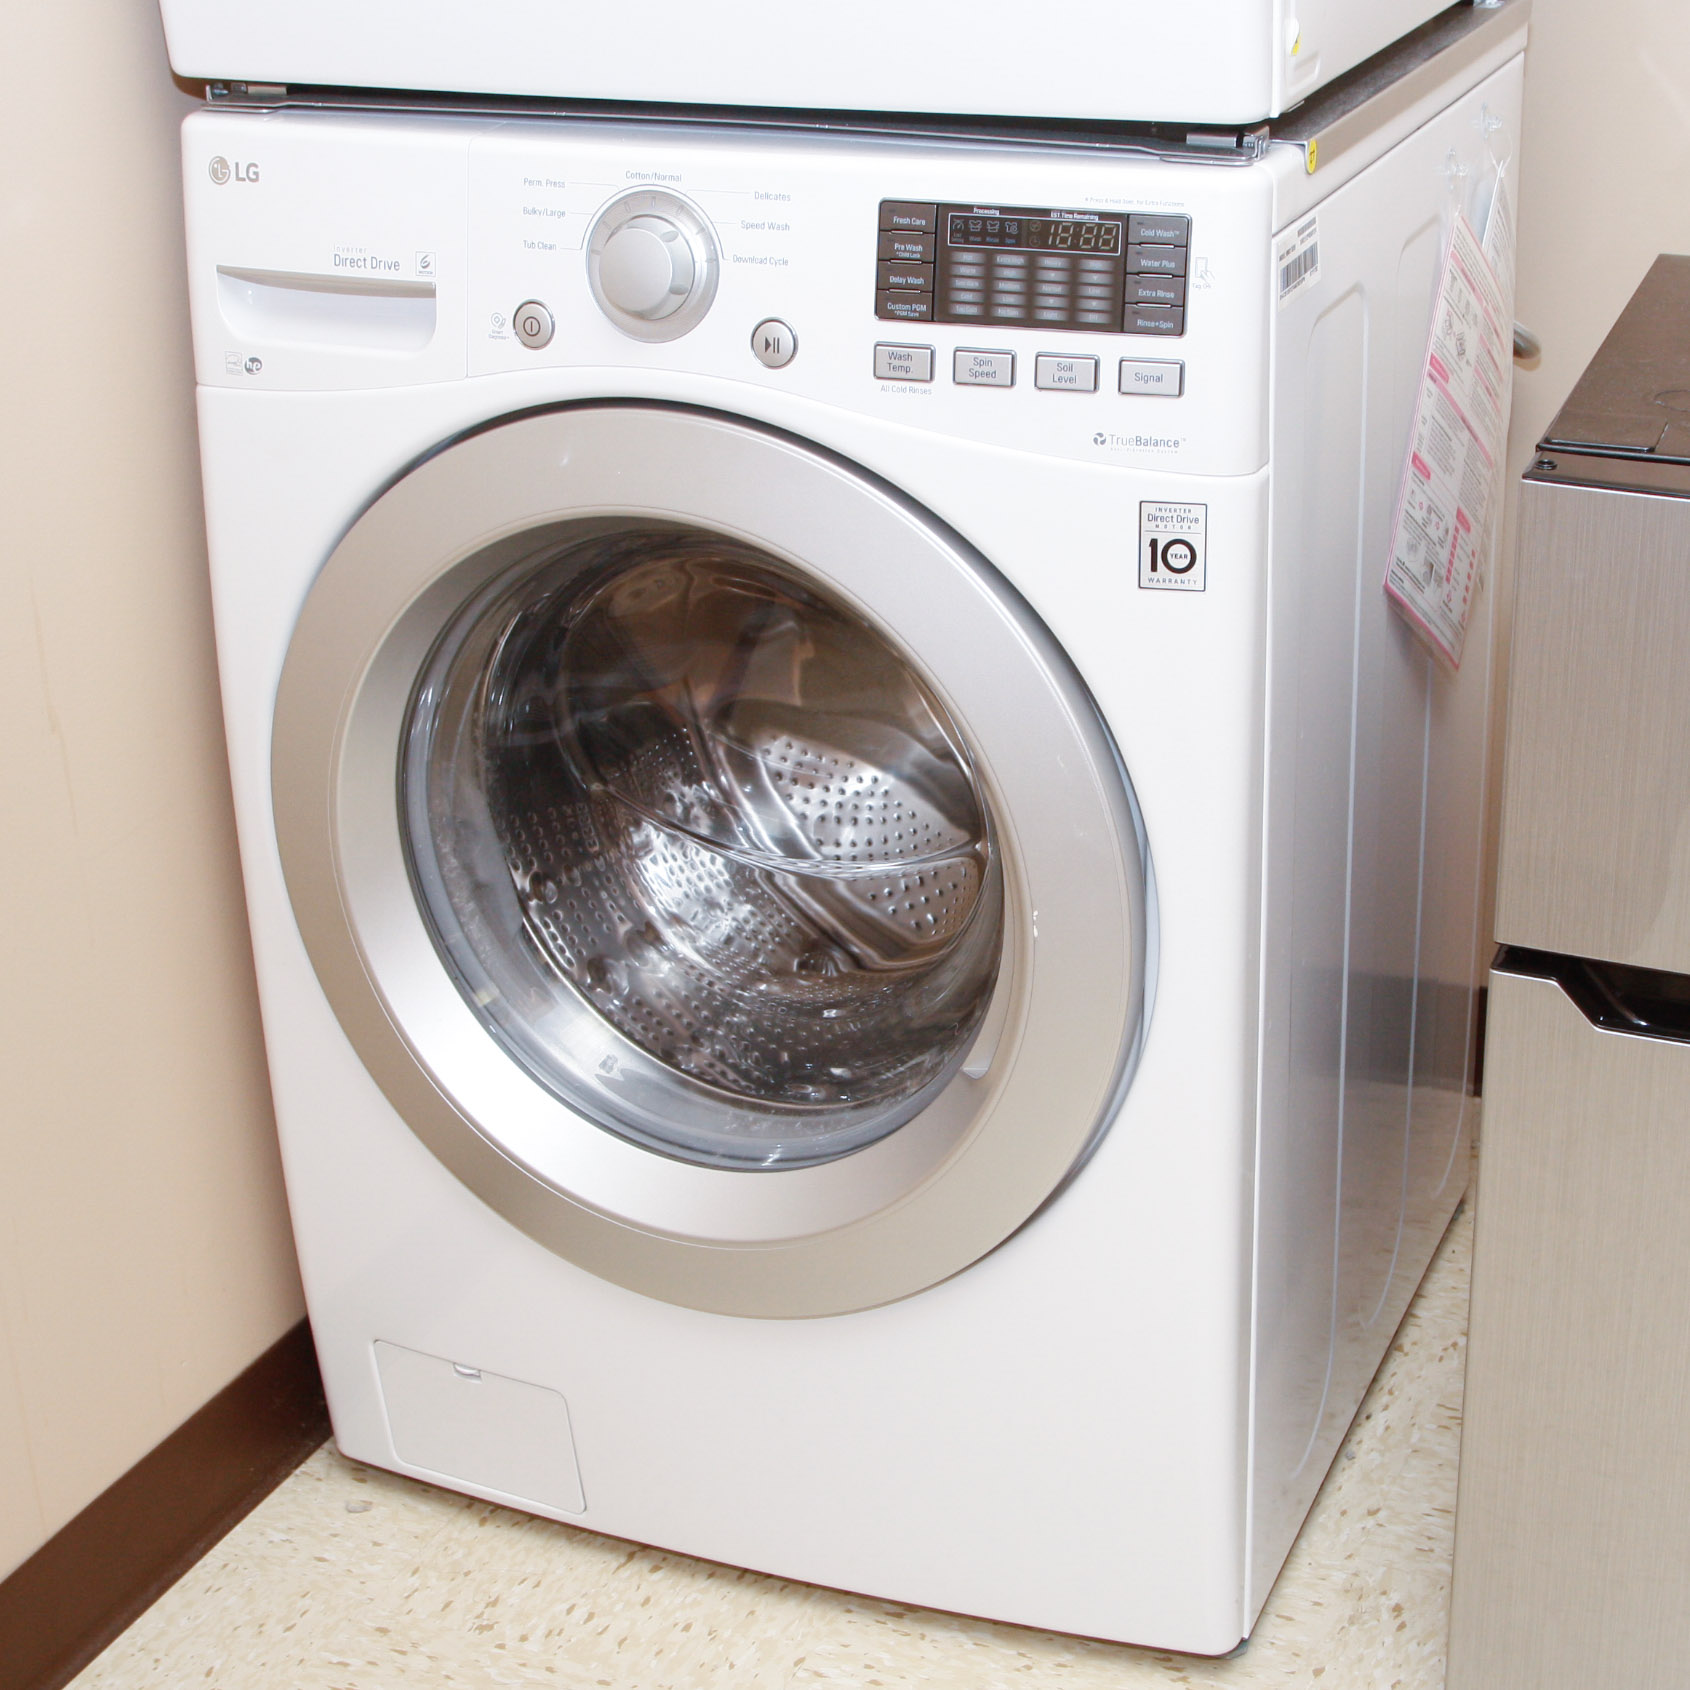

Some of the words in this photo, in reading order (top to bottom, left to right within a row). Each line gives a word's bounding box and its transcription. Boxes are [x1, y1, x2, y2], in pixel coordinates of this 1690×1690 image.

[235, 163, 260, 182] LG
[625, 171, 682, 182] Cotton/Normal
[523, 178, 544, 188] Perm.
[546, 179, 566, 189] Press
[754, 192, 791, 202] Delicates
[523, 207, 566, 219] Bulky/Large
[741, 221, 765, 232] Speed
[767, 222, 790, 232] Wash
[893, 216, 910, 225] Fresh
[911, 217, 926, 226] Care
[1140, 228, 1155, 237] Cold
[523, 240, 536, 250] Tub
[537, 241, 557, 251] Clean
[894, 243, 905, 251] Pre
[906, 244, 923, 252] Wash
[334, 253, 367, 269] Direct
[370, 256, 400, 271] Drive
[733, 255, 767, 265] Download
[768, 257, 789, 267] Cycle
[1140, 258, 1161, 268] Water
[1162, 260, 1176, 268] Plus
[889, 276, 906, 285] Delay
[907, 277, 924, 285] Wash
[1138, 289, 1156, 297] Extra
[1156, 290, 1175, 298] Rinse
[887, 302, 911, 311] Custom
[912, 304, 927, 312] PGM
[888, 351, 913, 362] Wash
[887, 363, 914, 374] Temp.
[972, 357, 993, 369] Spin
[1056, 362, 1075, 373] Soil
[968, 368, 997, 380] Speed
[1052, 374, 1077, 385] Level
[1134, 373, 1164, 385] Signal
[880, 385, 890, 393] All
[891, 386, 907, 394] Cold
[908, 387, 932, 396] Rinses
[1147, 513, 1174, 523] Direct
[1176, 514, 1200, 524] Drive
[1148, 538, 1197, 574] 10
[1148, 577, 1198, 585] WARRANTY
